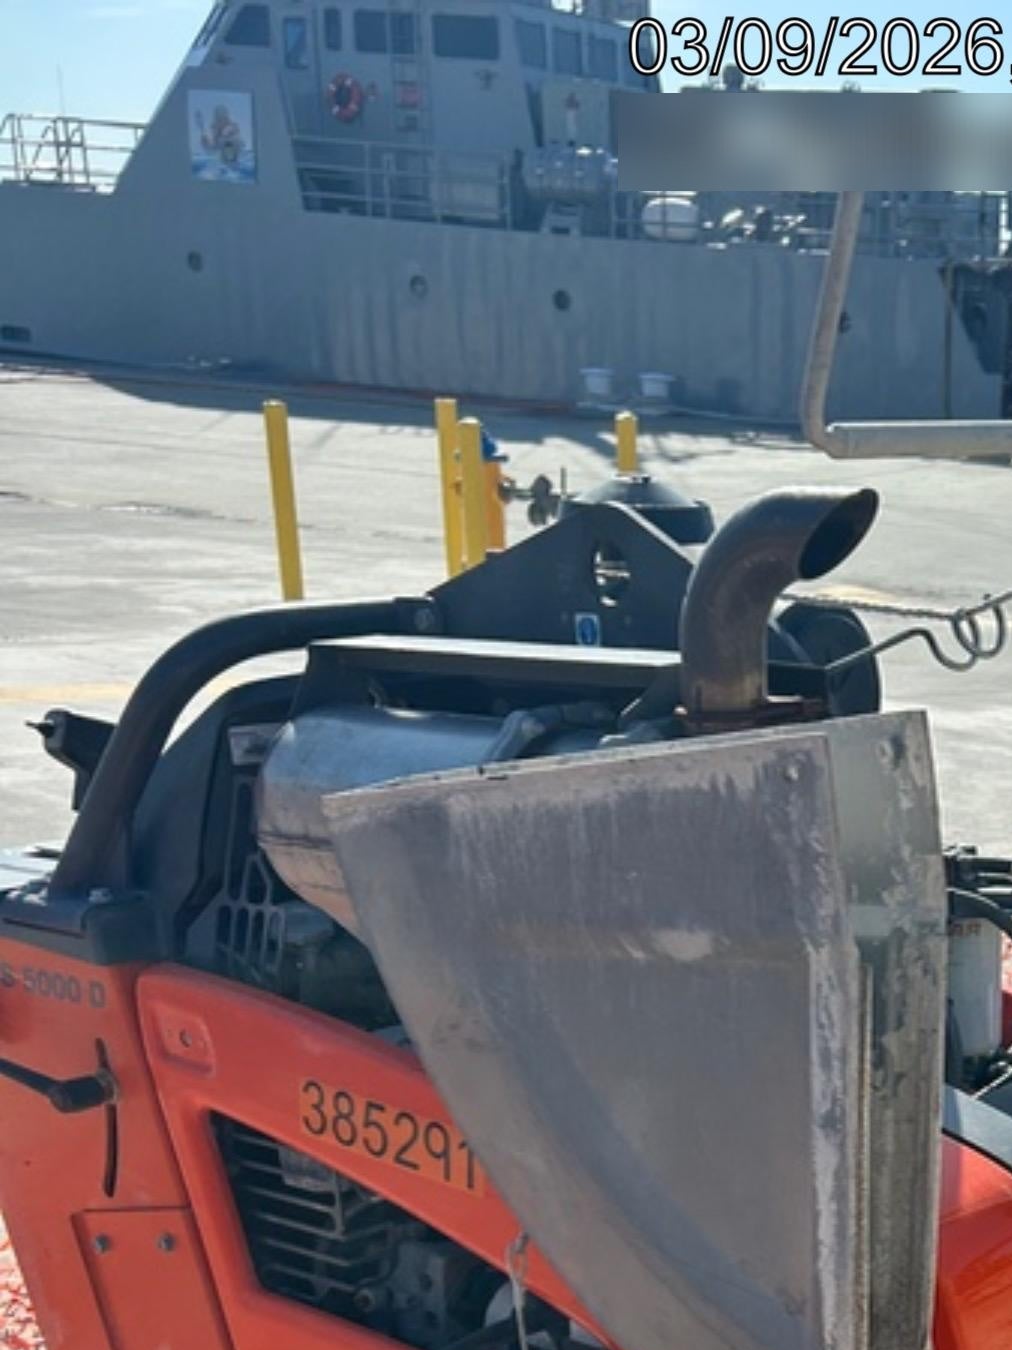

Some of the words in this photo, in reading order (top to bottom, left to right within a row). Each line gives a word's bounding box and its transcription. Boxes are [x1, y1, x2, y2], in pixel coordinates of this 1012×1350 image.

[22, 965, 81, 1002] 5000
[87, 980, 105, 1008] D
[302, 1080, 475, 1190] 385291
